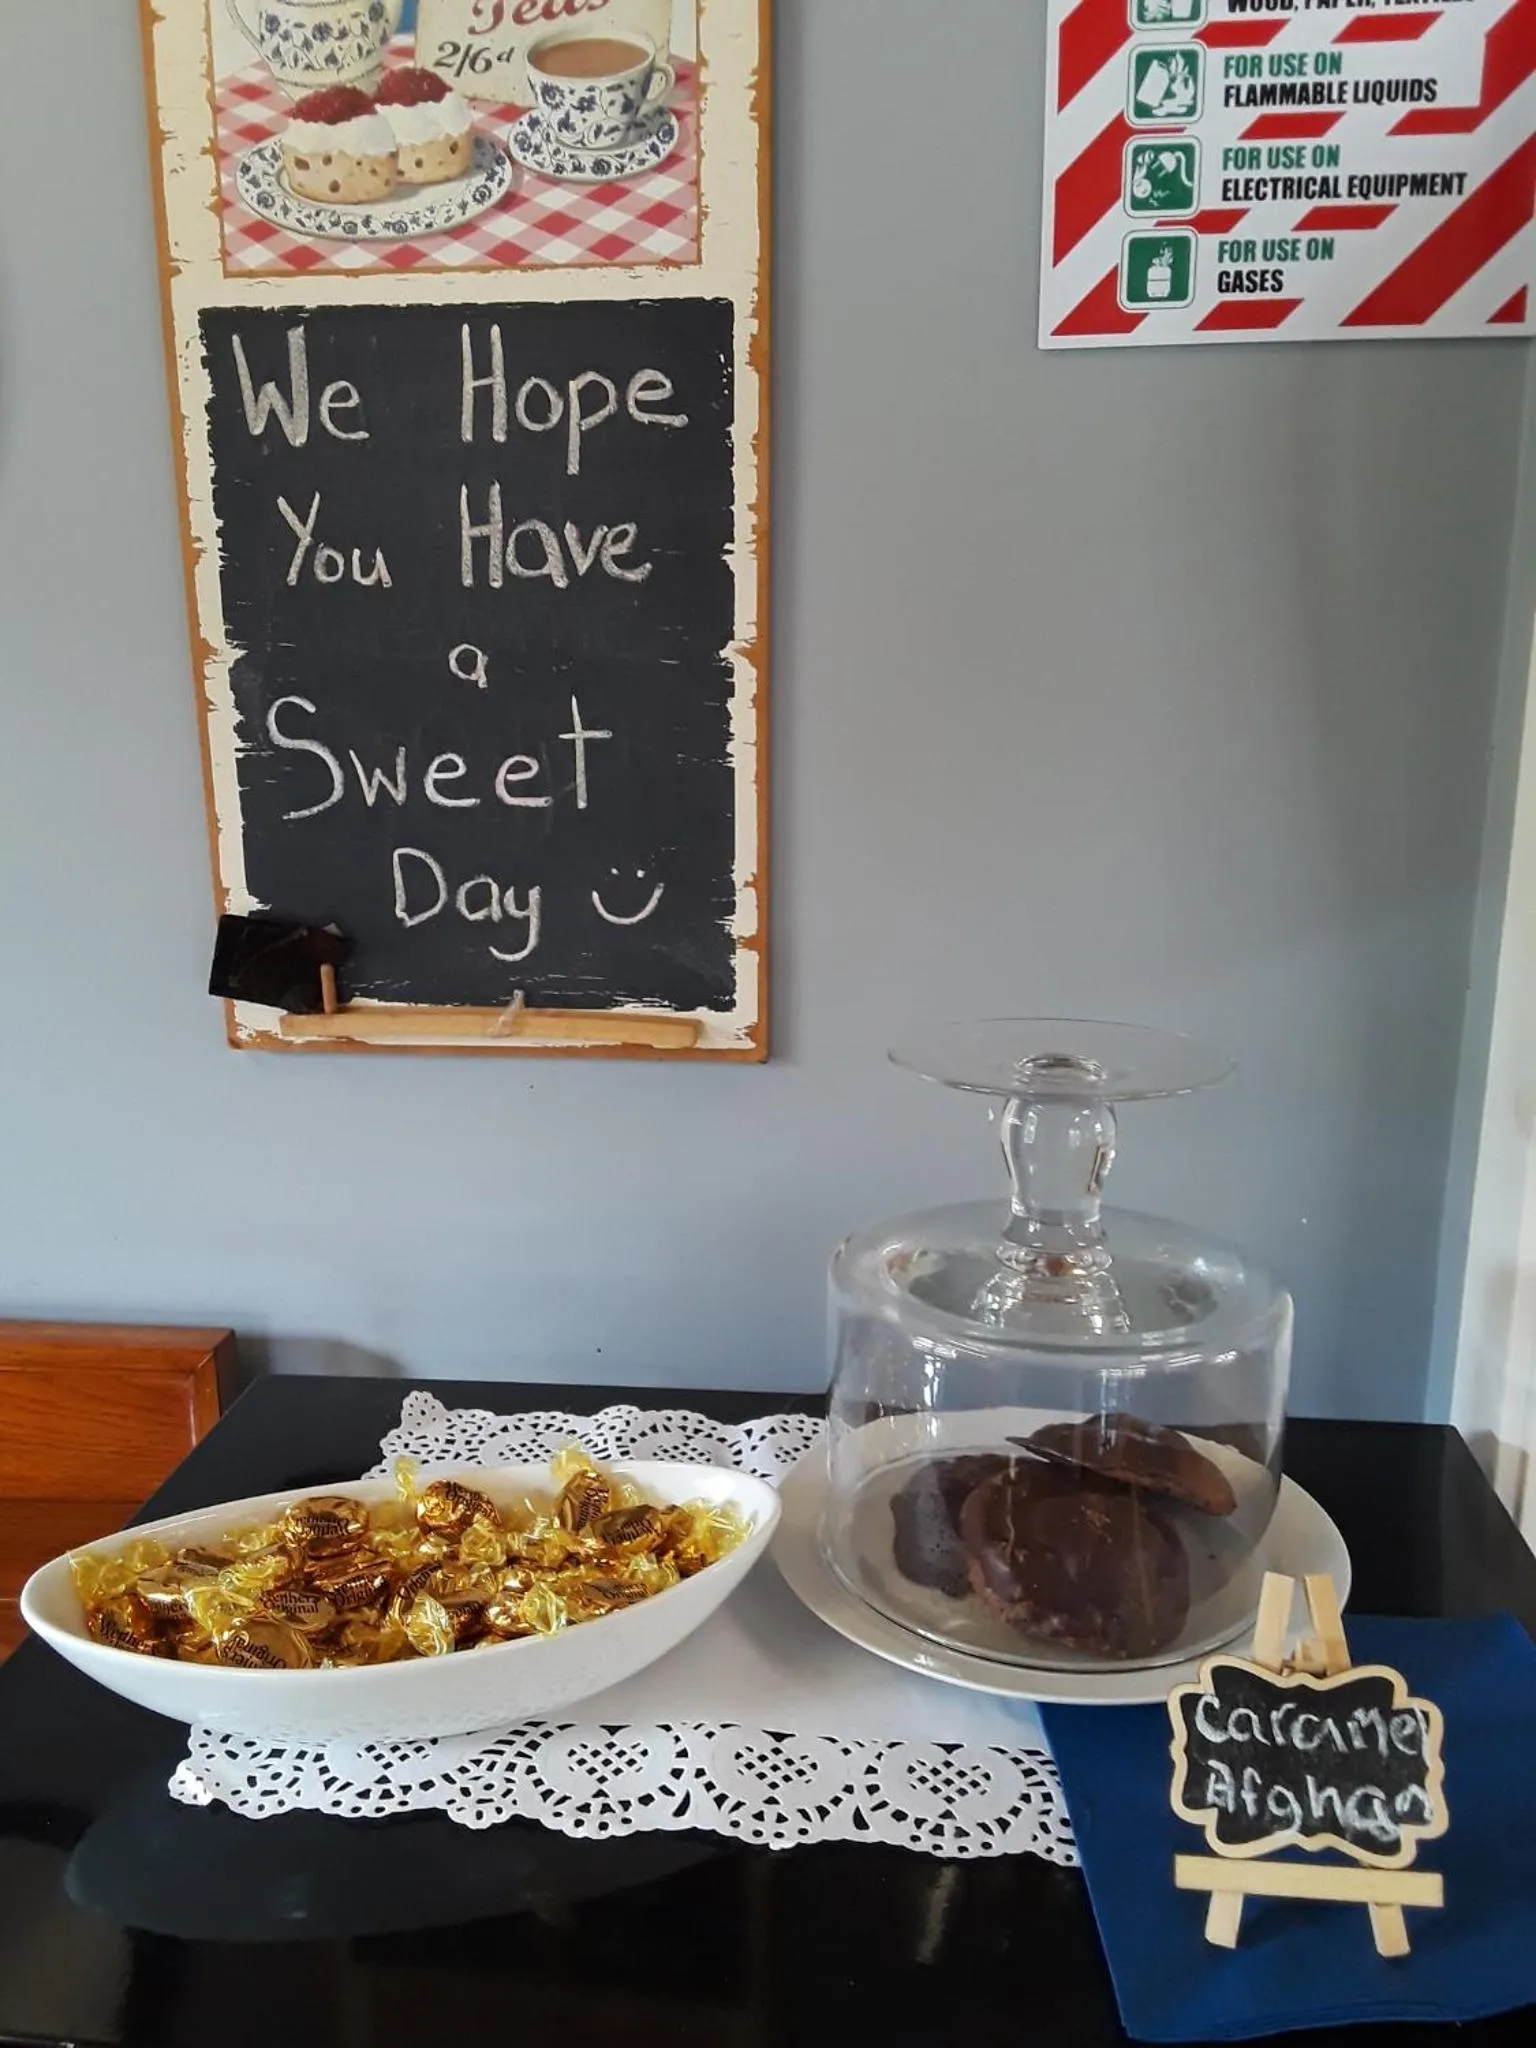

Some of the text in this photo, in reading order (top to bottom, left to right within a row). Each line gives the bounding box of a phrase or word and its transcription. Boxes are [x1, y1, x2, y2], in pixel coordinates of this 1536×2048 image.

[1224, 51, 1342, 78] FOR USE ON
[1224, 78, 1438, 107] FLAMMABLE LIQUIDS
[1223, 144, 1340, 171] FOR USE ON
[1222, 172, 1467, 201] ELECTRICAL EQUIPMENT
[1218, 236, 1335, 263] FOR USE ON
[1217, 268, 1284, 293] GASES
[231, 323, 688, 475] We Hope
[277, 479, 653, 588] You Have
[449, 643, 488, 689] a
[267, 695, 613, 819] Sweet
[393, 847, 541, 961] Day
[1206, 1759, 1433, 1842] Afghan
